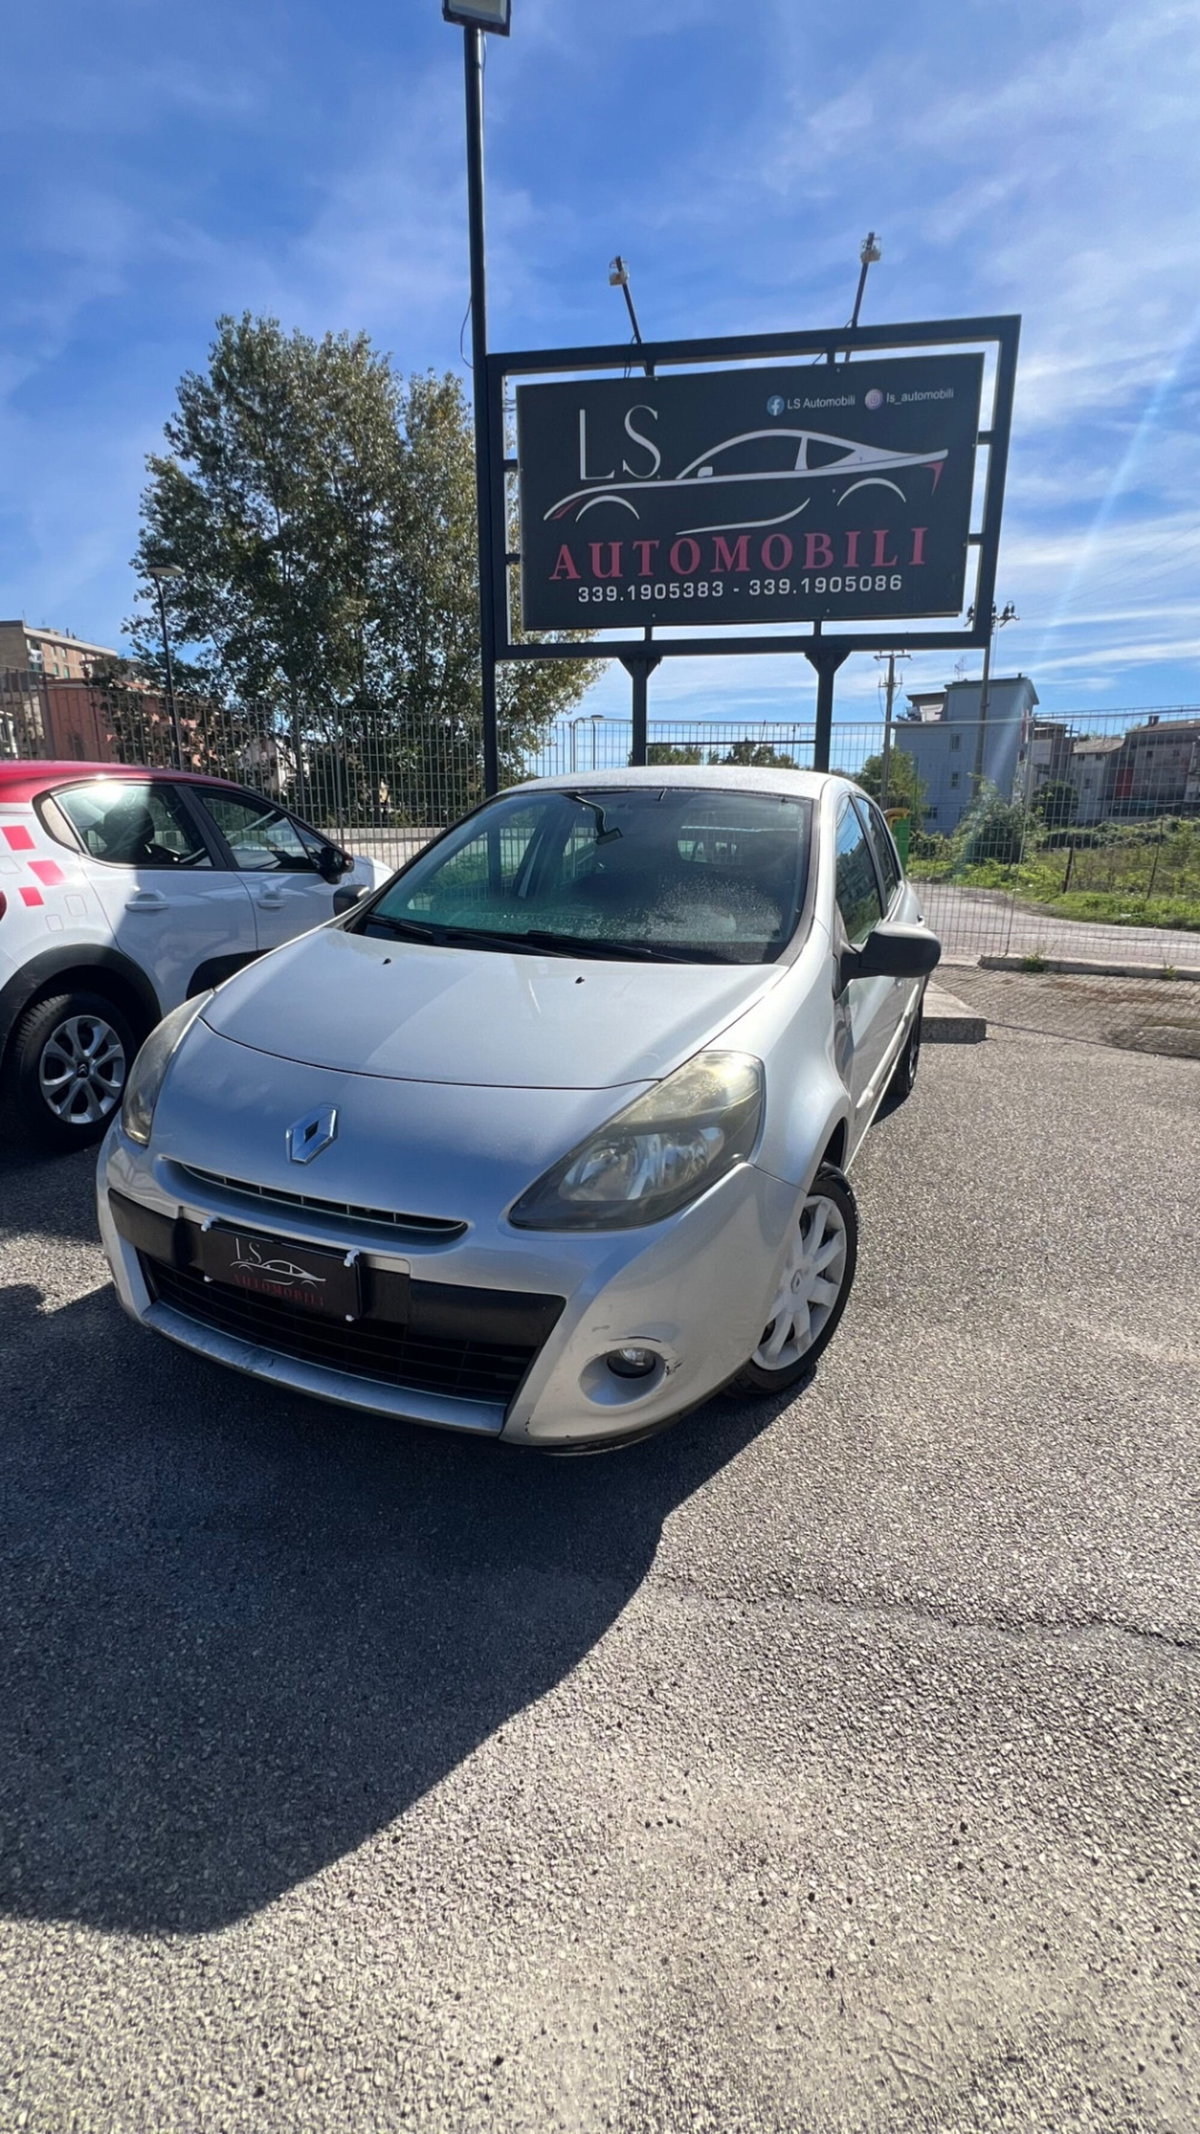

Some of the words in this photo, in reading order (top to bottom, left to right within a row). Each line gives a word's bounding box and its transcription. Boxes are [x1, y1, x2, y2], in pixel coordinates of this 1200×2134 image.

[787, 398, 801, 410] LS
[803, 394, 856, 409] Automobili
[886, 388, 954, 405] ls_automobili
[579, 405, 661, 481] LS
[549, 527, 928, 580] AUTOMOBILI
[578, 581, 724, 603] 339.1905383
[749, 575, 903, 597] 339.1905086
